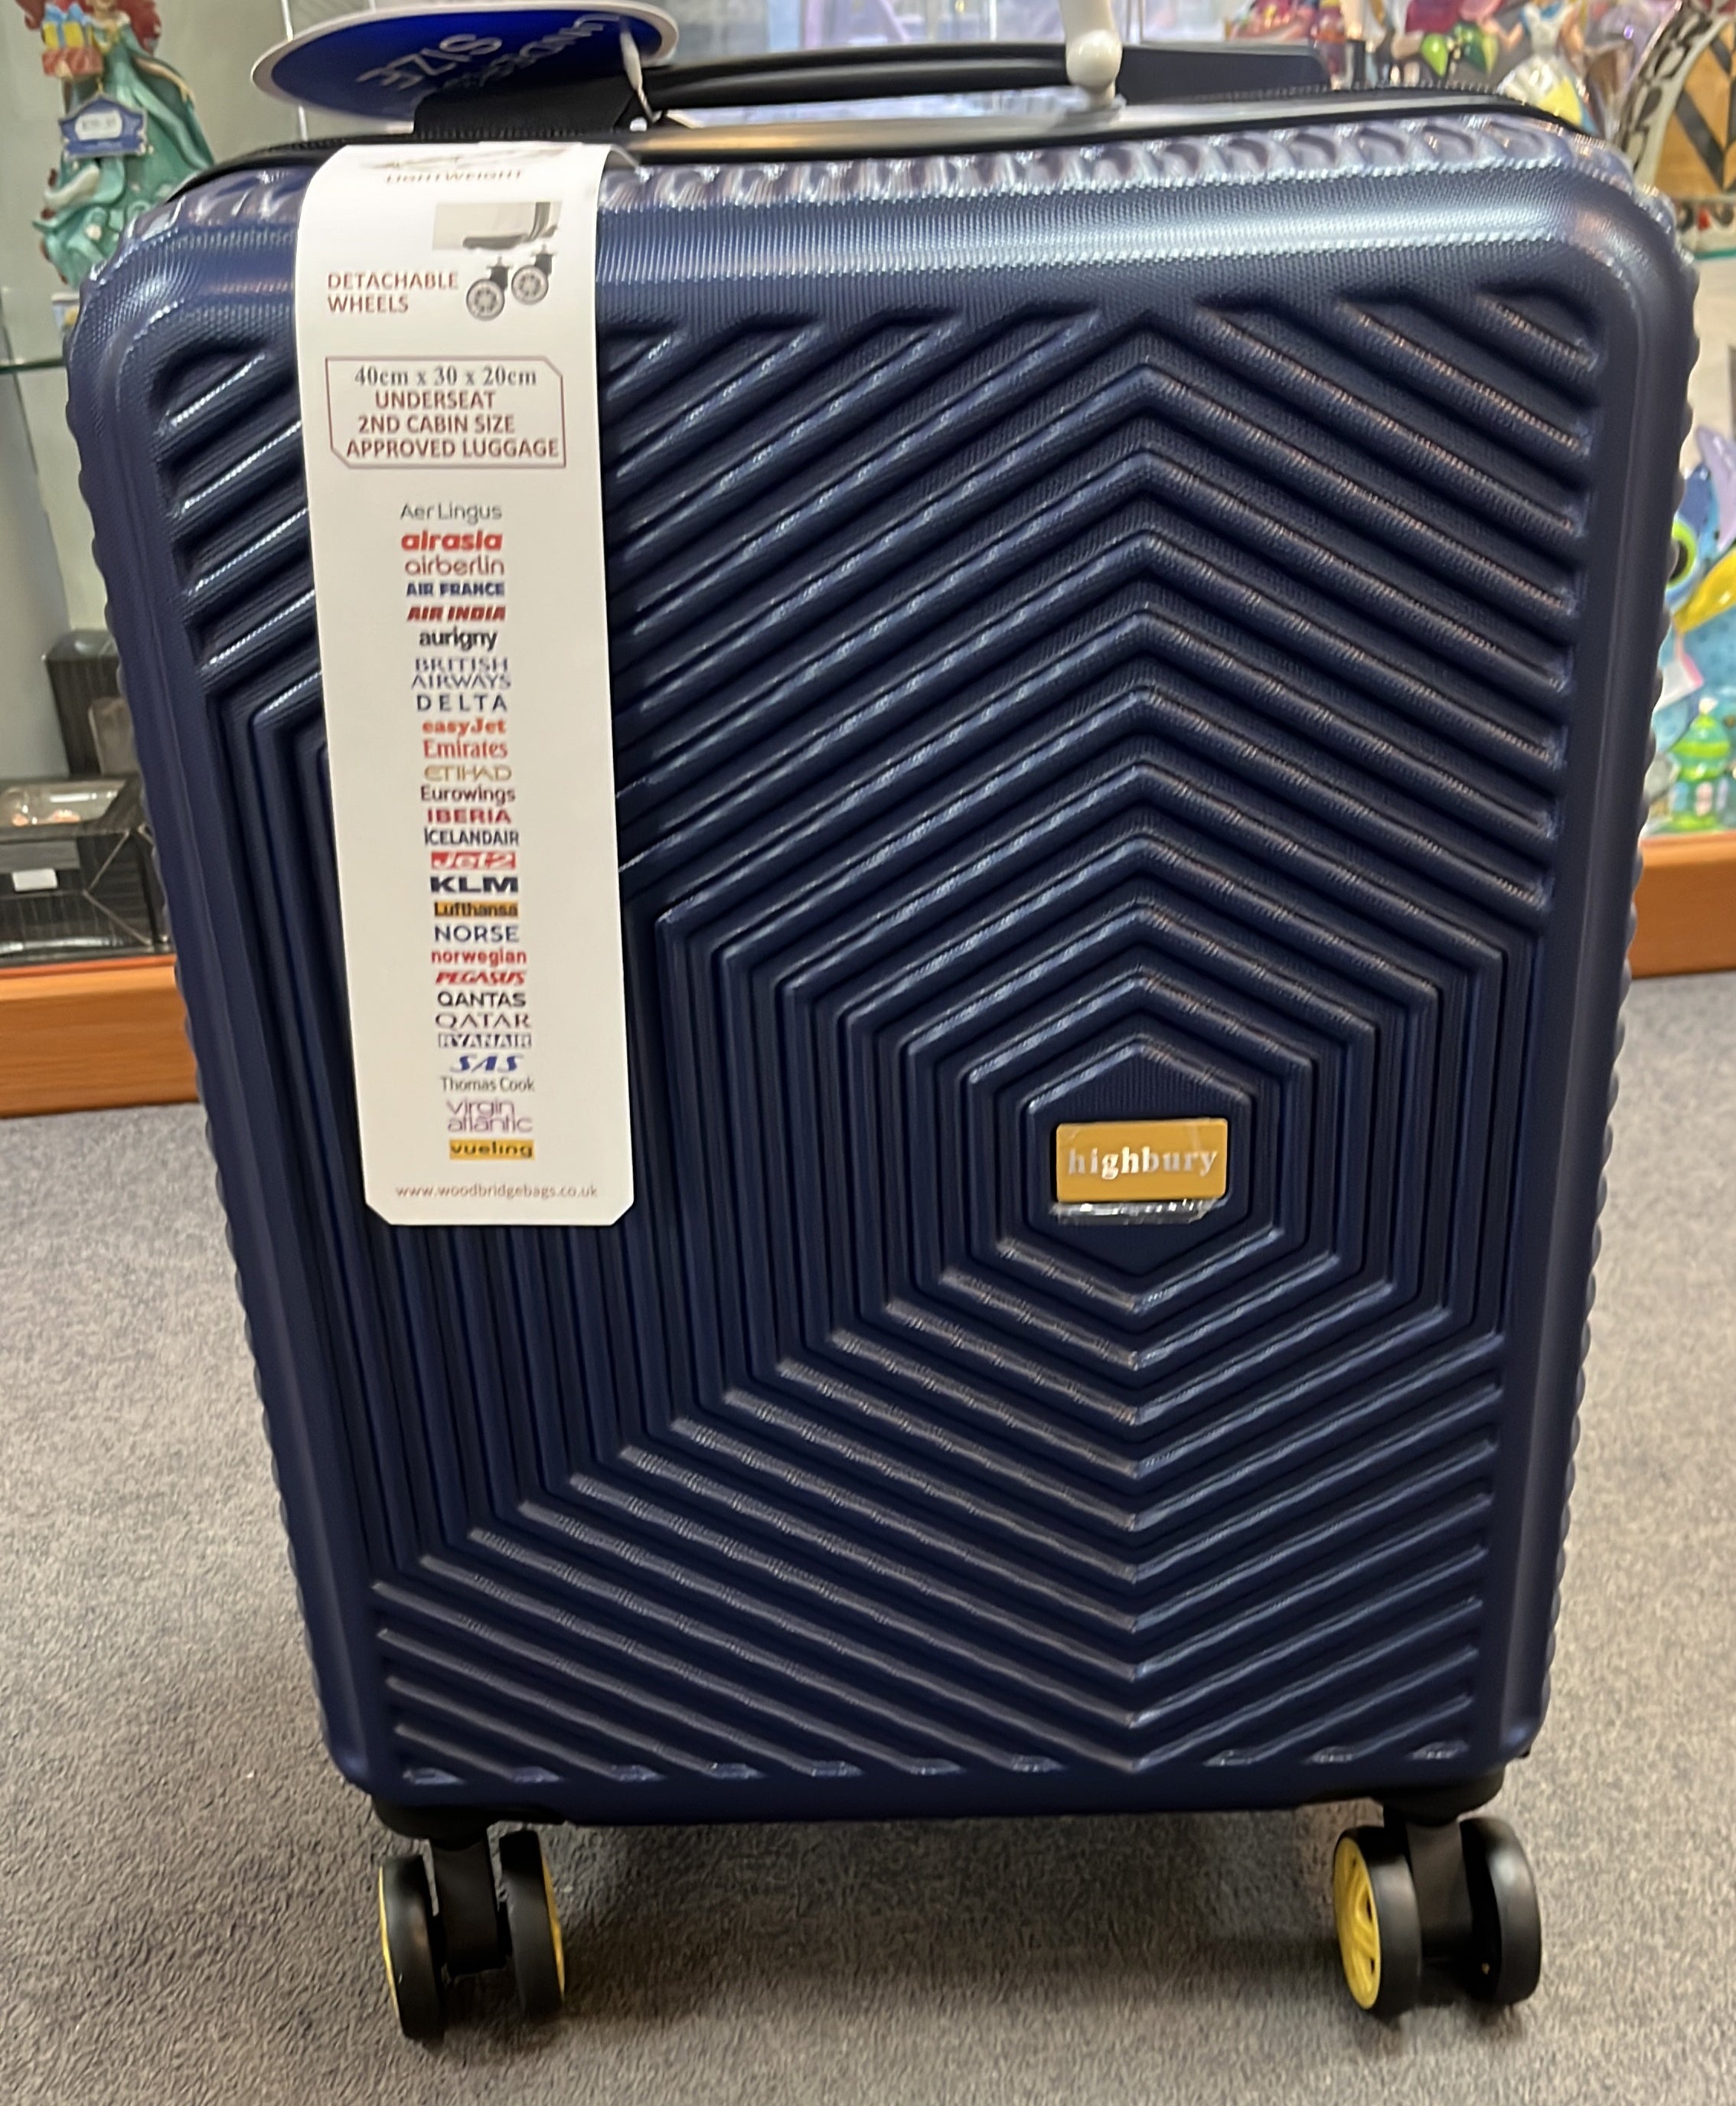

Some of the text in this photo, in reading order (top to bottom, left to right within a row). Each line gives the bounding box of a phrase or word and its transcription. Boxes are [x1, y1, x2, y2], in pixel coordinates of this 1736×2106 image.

[328, 273, 458, 289] DETACHABLE
[328, 297, 409, 313] WHEELS
[354, 365, 537, 386] 40cm x 30 x 20cm
[375, 390, 496, 410] UNDERSEAT
[357, 414, 515, 434] 2ND CABIN SIZE
[346, 439, 560, 459] APPROVED LUGGAGE
[400, 501, 502, 525] Aer Lingus
[401, 529, 503, 551] airasia
[405, 555, 504, 576] airberlin
[406, 583, 505, 597] AIR FRANCE
[406, 606, 506, 622] AIR INDIA
[419, 625, 498, 651] aurigny
[415, 658, 507, 672] BRITISH
[411, 674, 511, 689] AIRWAYS
[416, 694, 507, 712] DELTA
[423, 717, 506, 736] easyJet
[423, 739, 507, 758] Emirates
[421, 784, 515, 806] Eurowings
[427, 808, 511, 823] IBERIA
[424, 827, 519, 845] ICELANDAIR
[430, 877, 518, 893] KLM
[434, 902, 518, 917] Lufthansa
[435, 925, 519, 942] NORSE
[431, 948, 527, 967] norwegian
[435, 971, 527, 985] PEGASUS
[437, 991, 527, 1007] QANTAS
[435, 1013, 531, 1031] QATAR
[439, 1033, 532, 1048] RYANAIR
[449, 1054, 524, 1073] SAS
[441, 1076, 534, 1092] Thomas Cook
[445, 1098, 515, 1119] virgin
[448, 1115, 533, 1132] atlantic
[450, 1140, 534, 1158] vueling
[1067, 1145, 1219, 1180] highbury
[395, 1183, 598, 1200] www.woodbridgebags.co.uk
